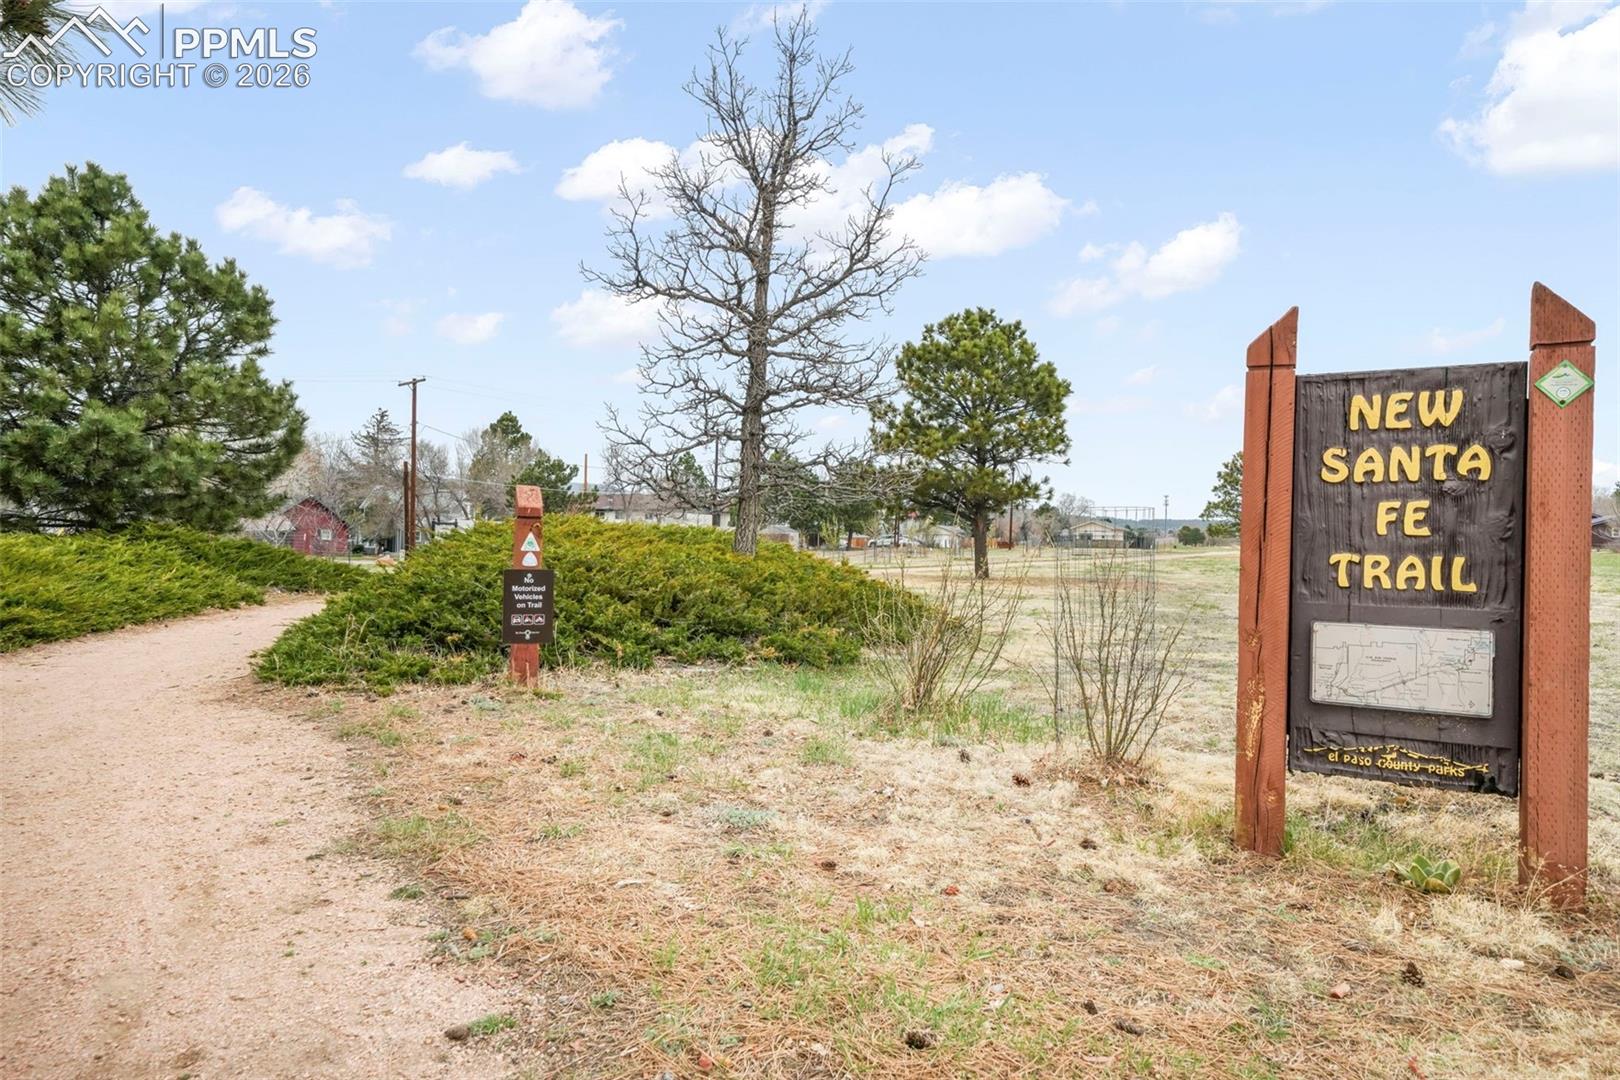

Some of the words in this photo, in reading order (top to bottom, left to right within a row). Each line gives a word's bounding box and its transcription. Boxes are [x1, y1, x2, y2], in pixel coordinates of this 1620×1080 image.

[1349, 389, 1464, 431] NEW
[1320, 443, 1492, 483] SANTA
[1376, 500, 1432, 537] FE
[1328, 552, 1478, 593] TRAIL
[1328, 752, 1339, 762] el
